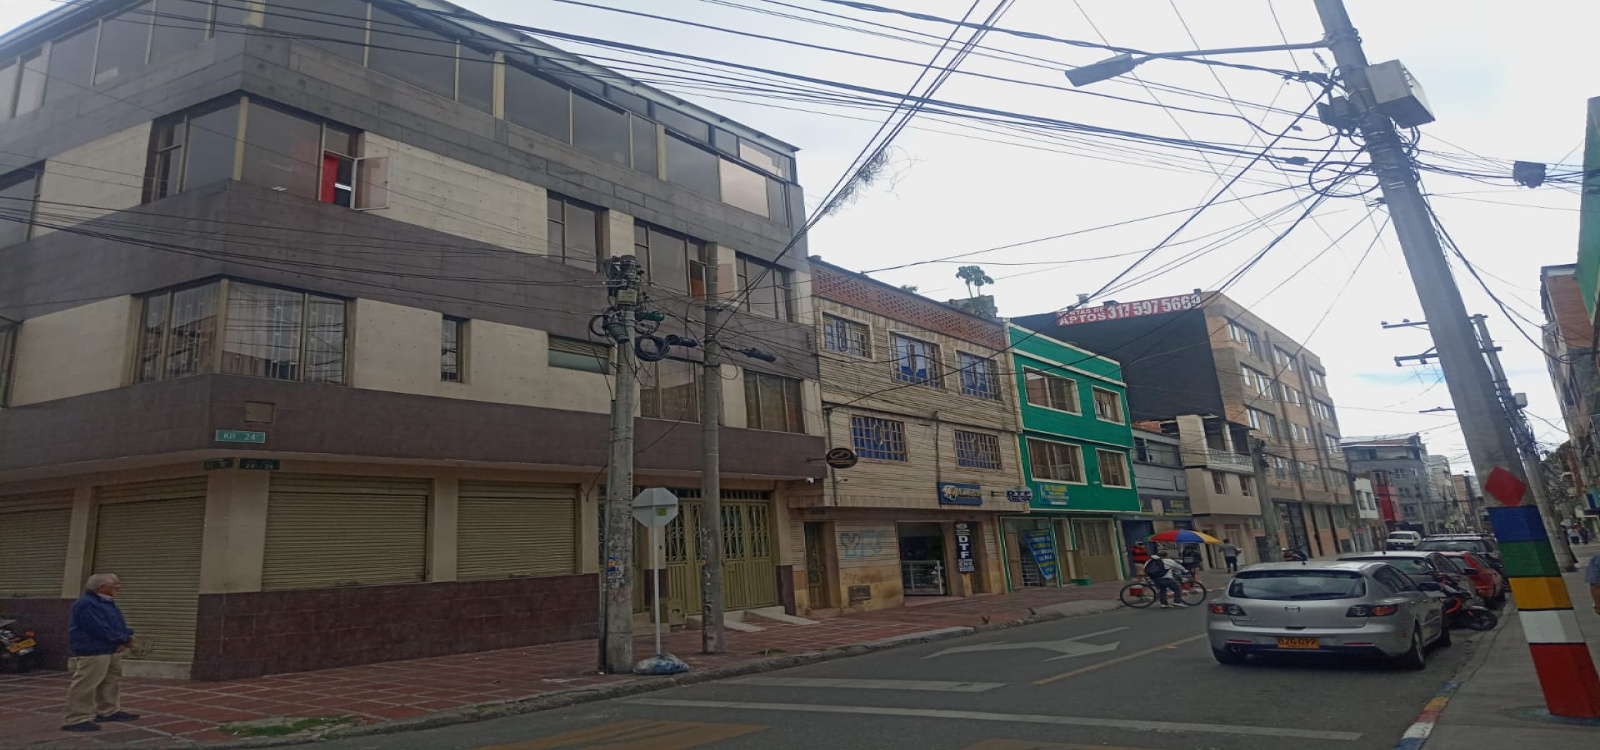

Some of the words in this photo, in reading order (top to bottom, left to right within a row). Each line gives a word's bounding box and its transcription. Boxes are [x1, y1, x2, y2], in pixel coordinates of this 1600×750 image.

[1059, 313, 1107, 326] APTOS
[1134, 299, 1158, 316] 597
[1161, 294, 1200, 312] 5669
[223, 432, 236, 440] KR
[243, 433, 256, 441] 24
[958, 535, 970, 559] DTF
